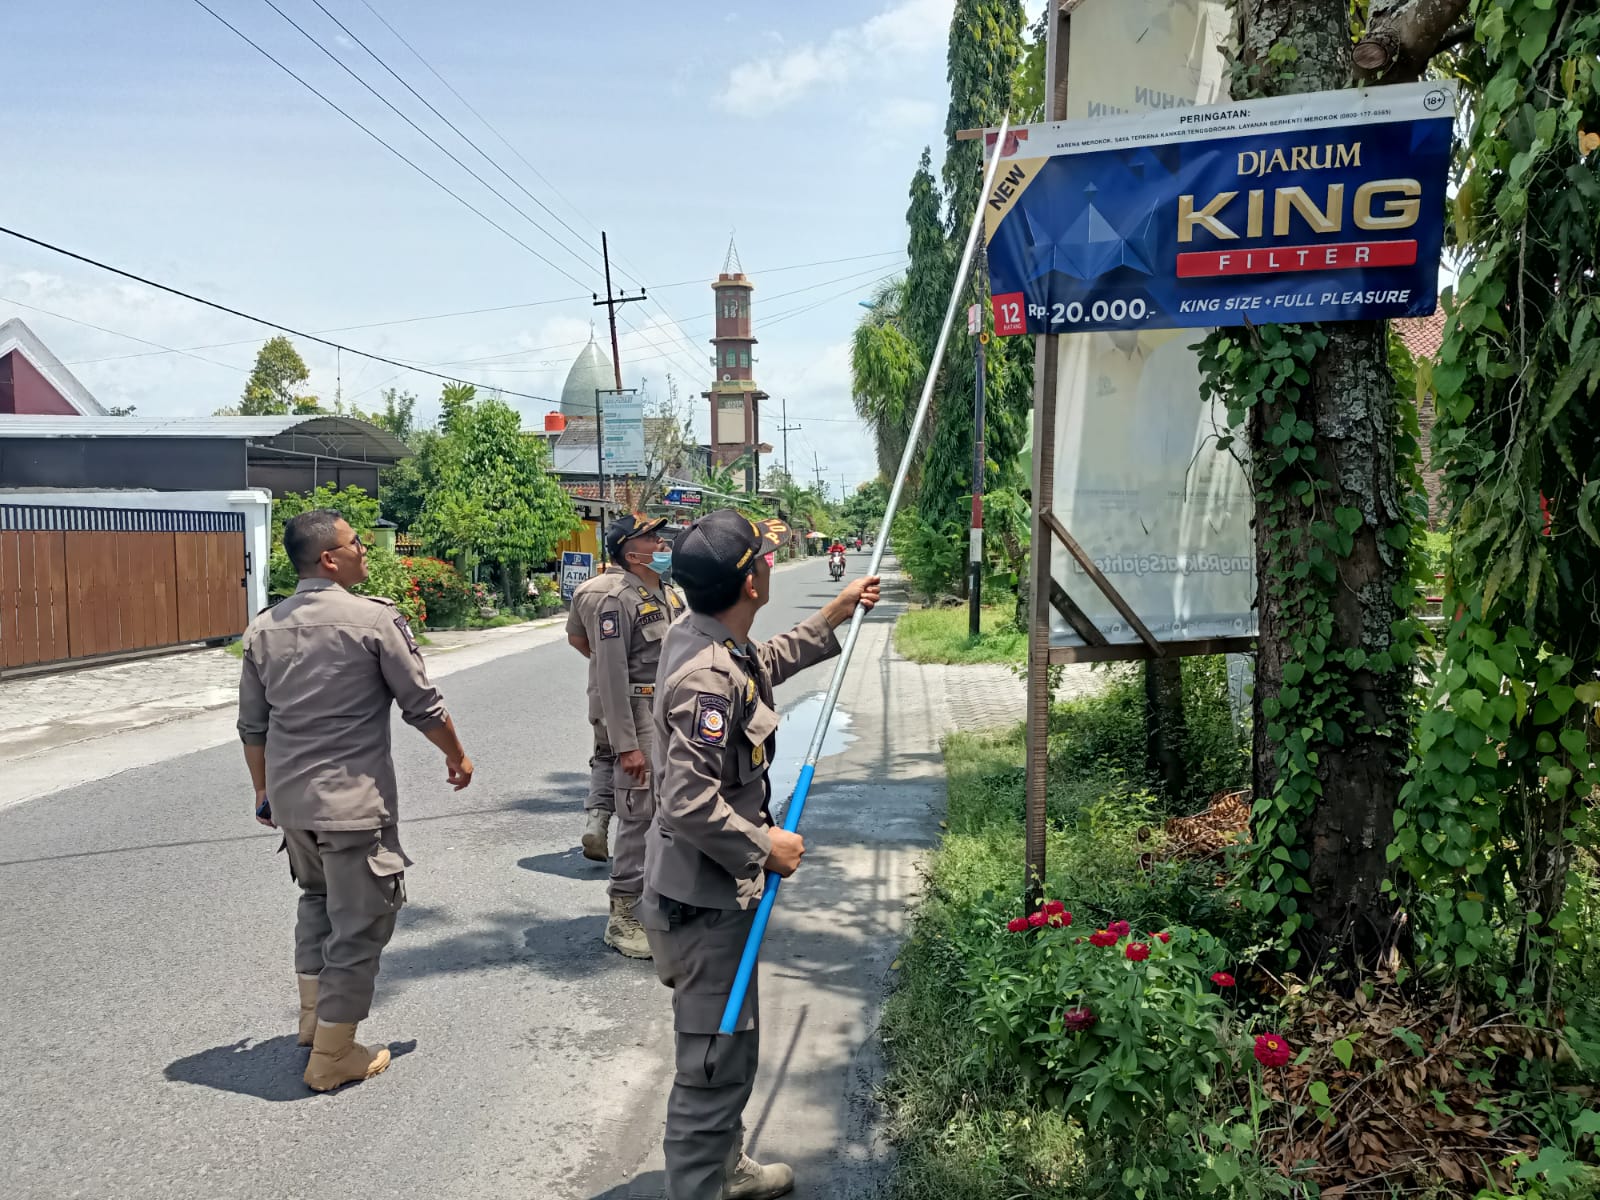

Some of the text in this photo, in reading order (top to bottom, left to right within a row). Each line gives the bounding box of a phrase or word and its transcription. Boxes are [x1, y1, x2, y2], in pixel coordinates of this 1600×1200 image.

[1427, 96, 1443, 105] 18+
[1131, 133, 1159, 141] TERKENA
[1160, 129, 1186, 138] KANKER
[1238, 121, 1268, 130] LAYANAN
[1269, 117, 1303, 127] BERHENTI
[1304, 113, 1338, 122] MEROKOK
[1180, 109, 1251, 124] PERINGATAN:
[1237, 142, 1361, 177] DJARUM
[989, 164, 1026, 211] NEW
[1177, 178, 1421, 242] KING
[1219, 246, 1370, 270] FILTER
[1001, 302, 1021, 324] 12
[1179, 289, 1411, 313] KING SIZE FULL PLEASURE
[566, 571, 588, 581] ATM
